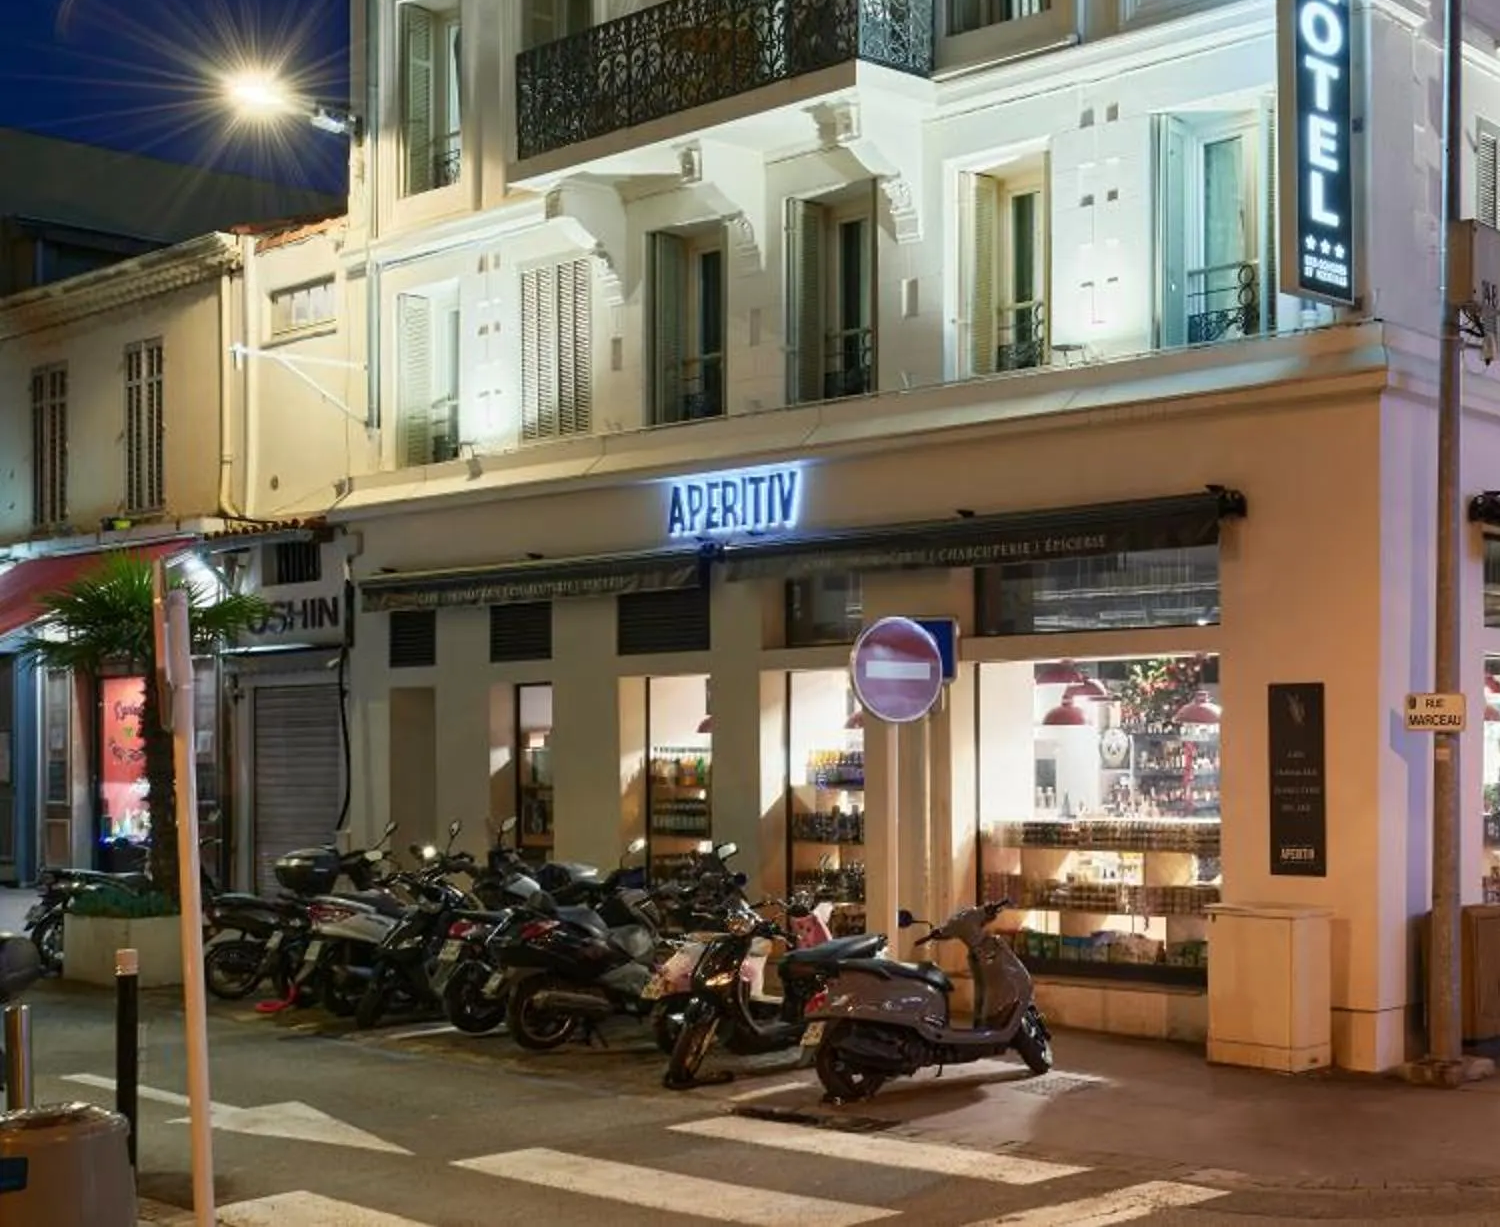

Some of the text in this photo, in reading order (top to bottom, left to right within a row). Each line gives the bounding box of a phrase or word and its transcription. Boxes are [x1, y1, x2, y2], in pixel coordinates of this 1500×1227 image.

[669, 471, 798, 534] APERITIV
[1425, 698, 1445, 709] RUE
[1408, 714, 1461, 726] MARCEAU
